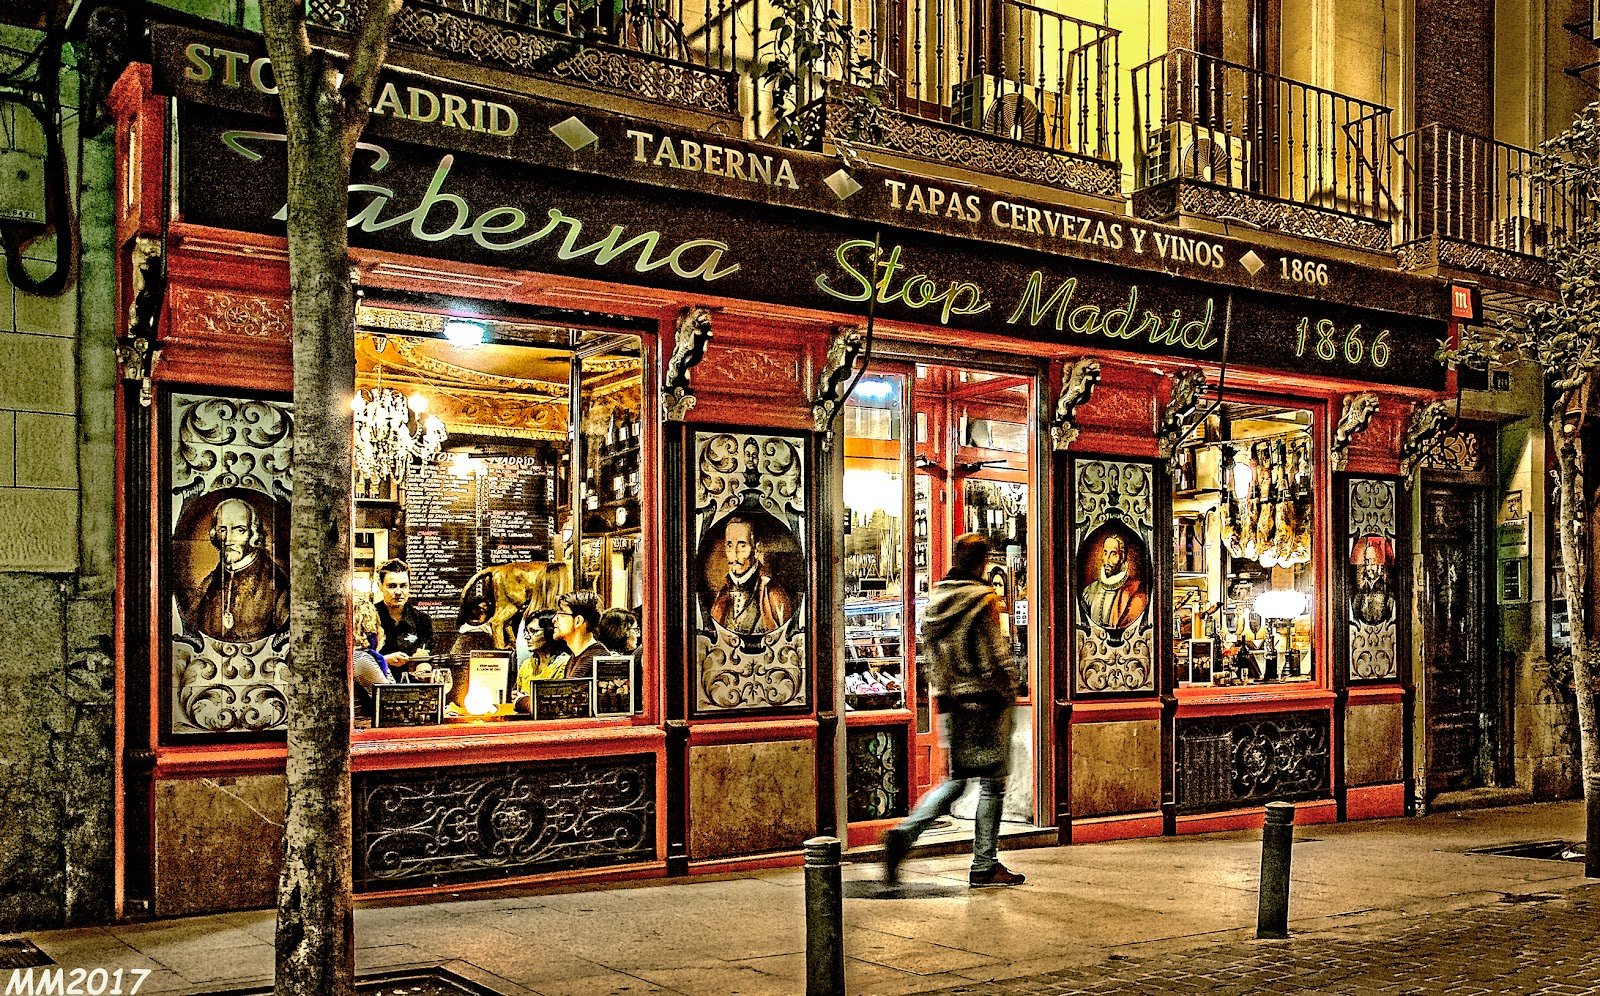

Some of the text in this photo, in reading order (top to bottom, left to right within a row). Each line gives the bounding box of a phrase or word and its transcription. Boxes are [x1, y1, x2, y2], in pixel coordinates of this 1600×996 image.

[185, 43, 519, 137] STO ADRID
[626, 129, 800, 190] TABERNA
[884, 178, 1225, 269] TAPAS CERVEZAS Y VINOS
[814, 239, 992, 325] Stop
[1006, 270, 1218, 351] Madrid
[1295, 316, 1390, 368] 1866
[1279, 256, 1329, 287] 1866
